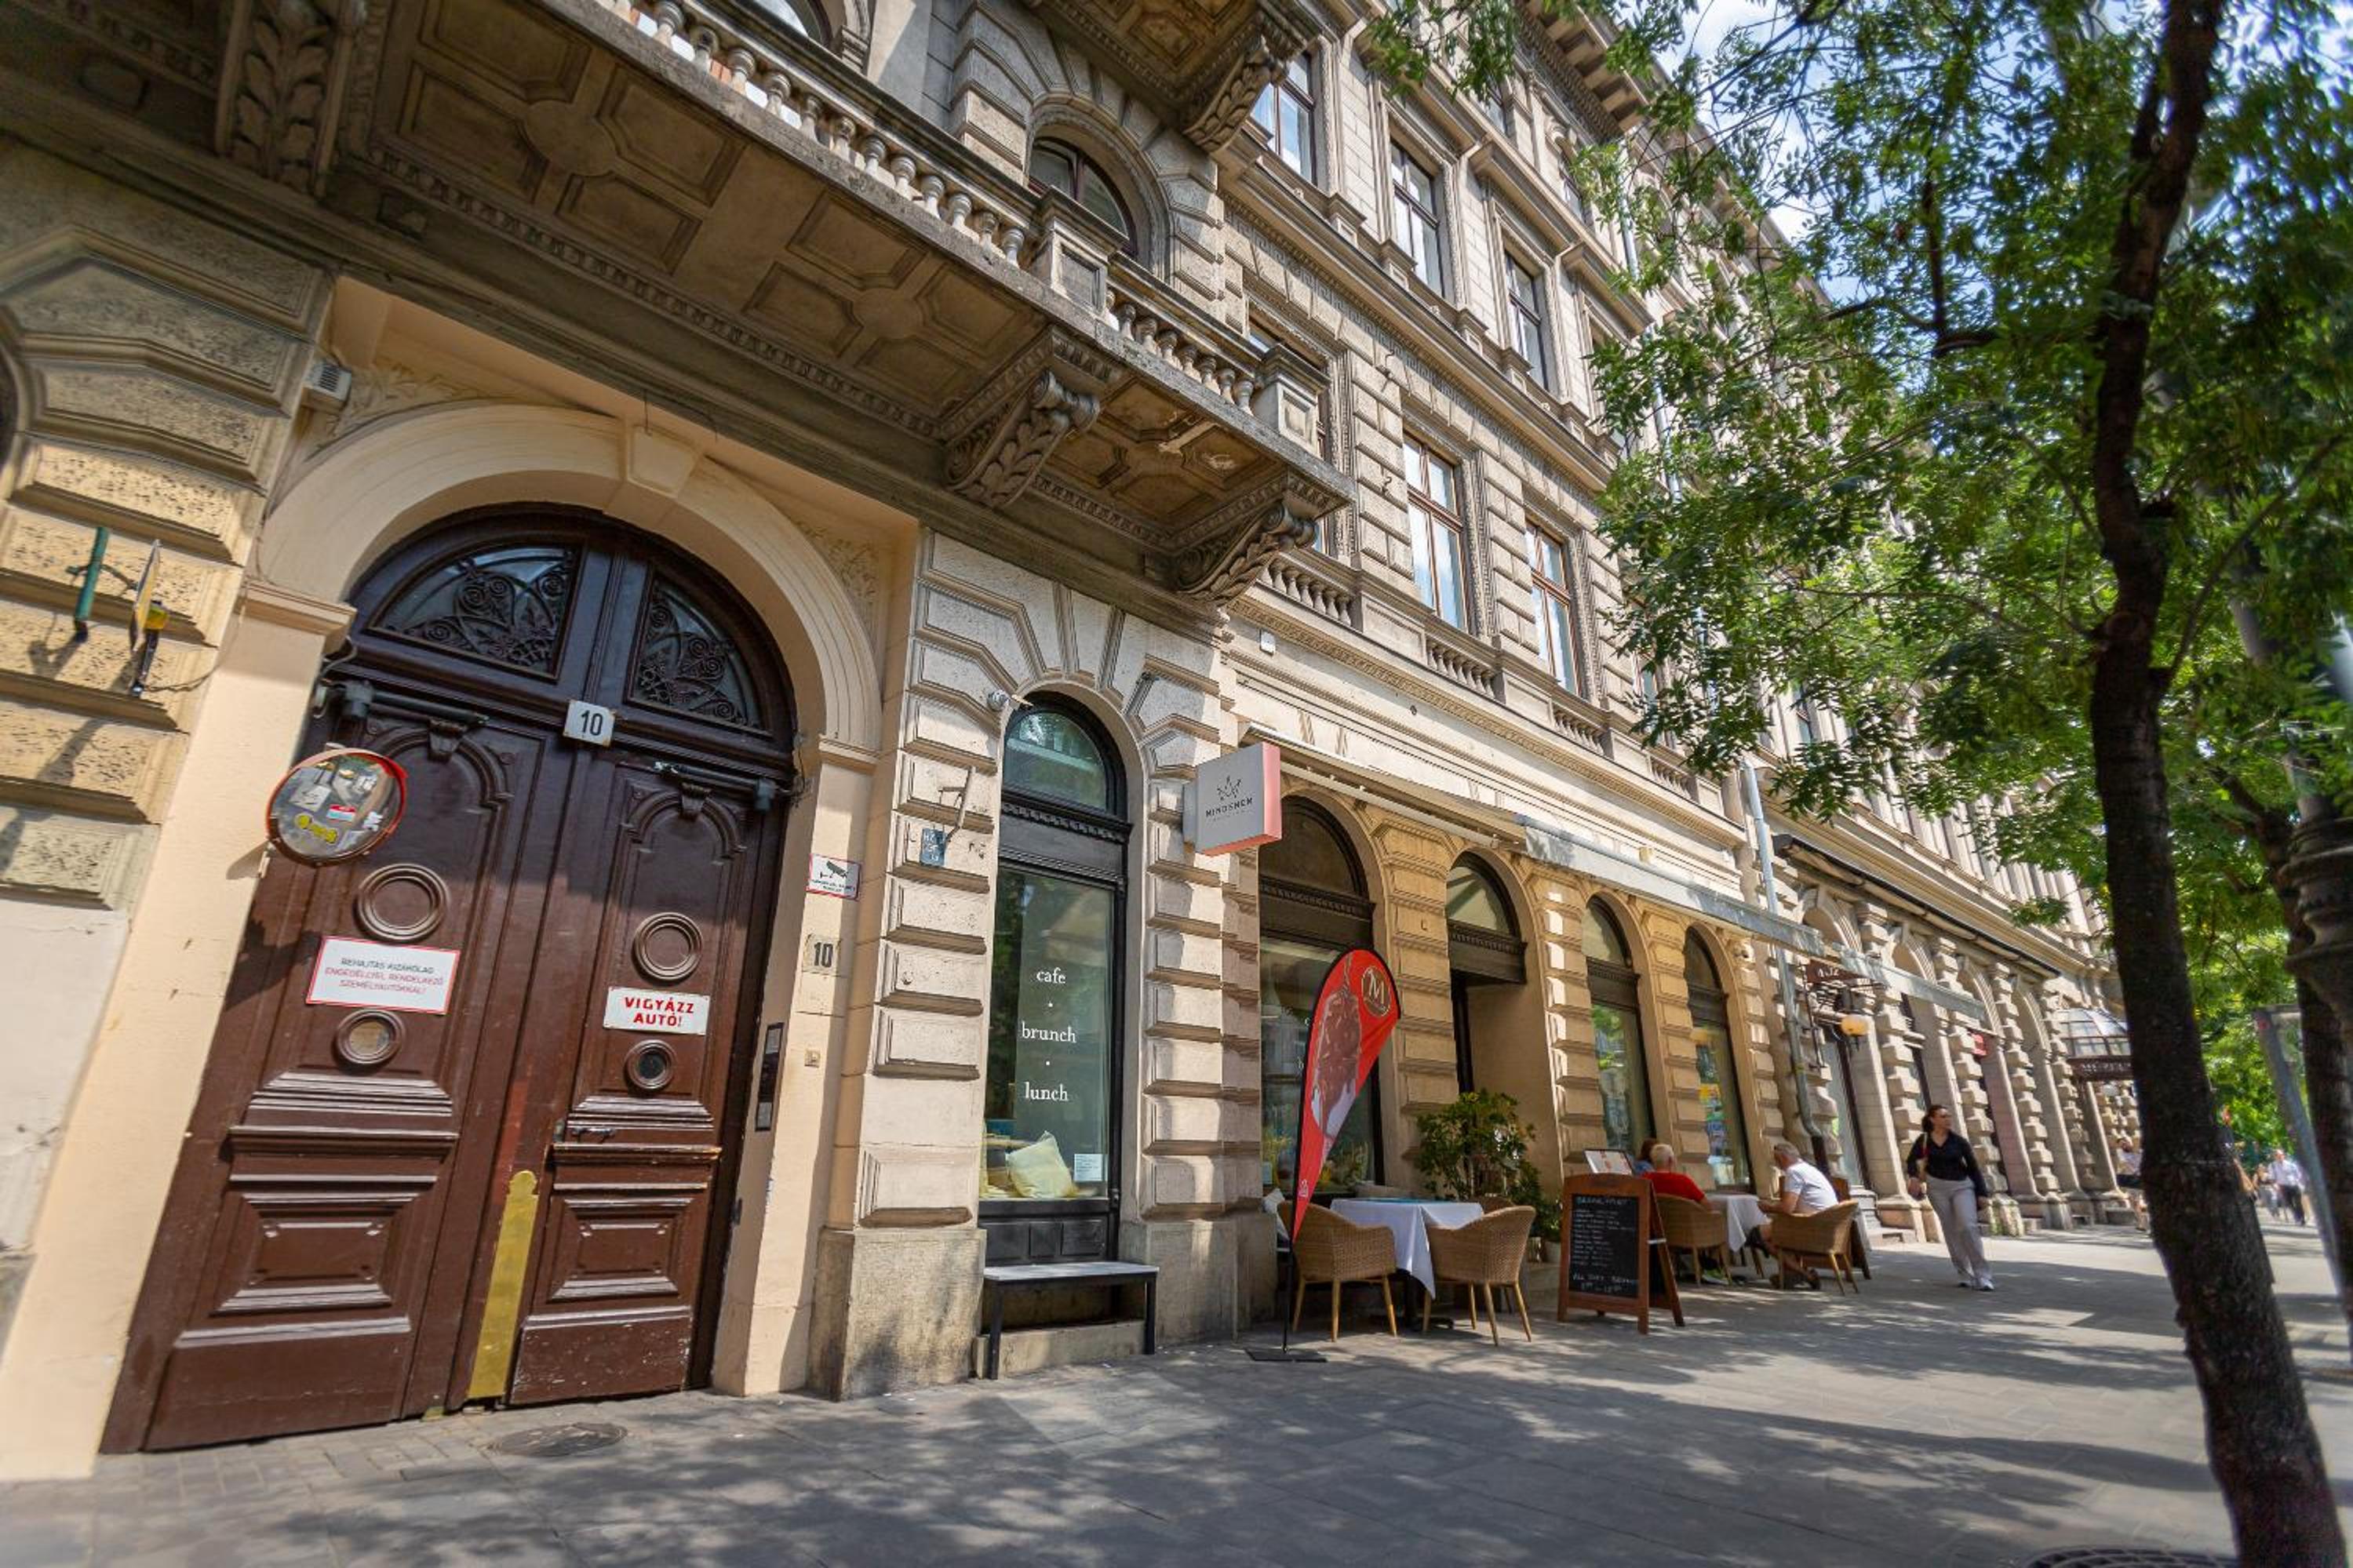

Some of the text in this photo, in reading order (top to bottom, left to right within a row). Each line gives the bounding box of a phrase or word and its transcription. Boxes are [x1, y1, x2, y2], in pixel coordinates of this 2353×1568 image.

[581, 710, 603, 736] 10
[814, 942, 833, 968] 10
[1036, 967, 1066, 984] cafe
[625, 997, 695, 1014] VIGYÁZZ
[633, 1012, 683, 1028] AUTÓ!
[1022, 1020, 1077, 1043] brunch
[1025, 1081, 1069, 1102] lunch
